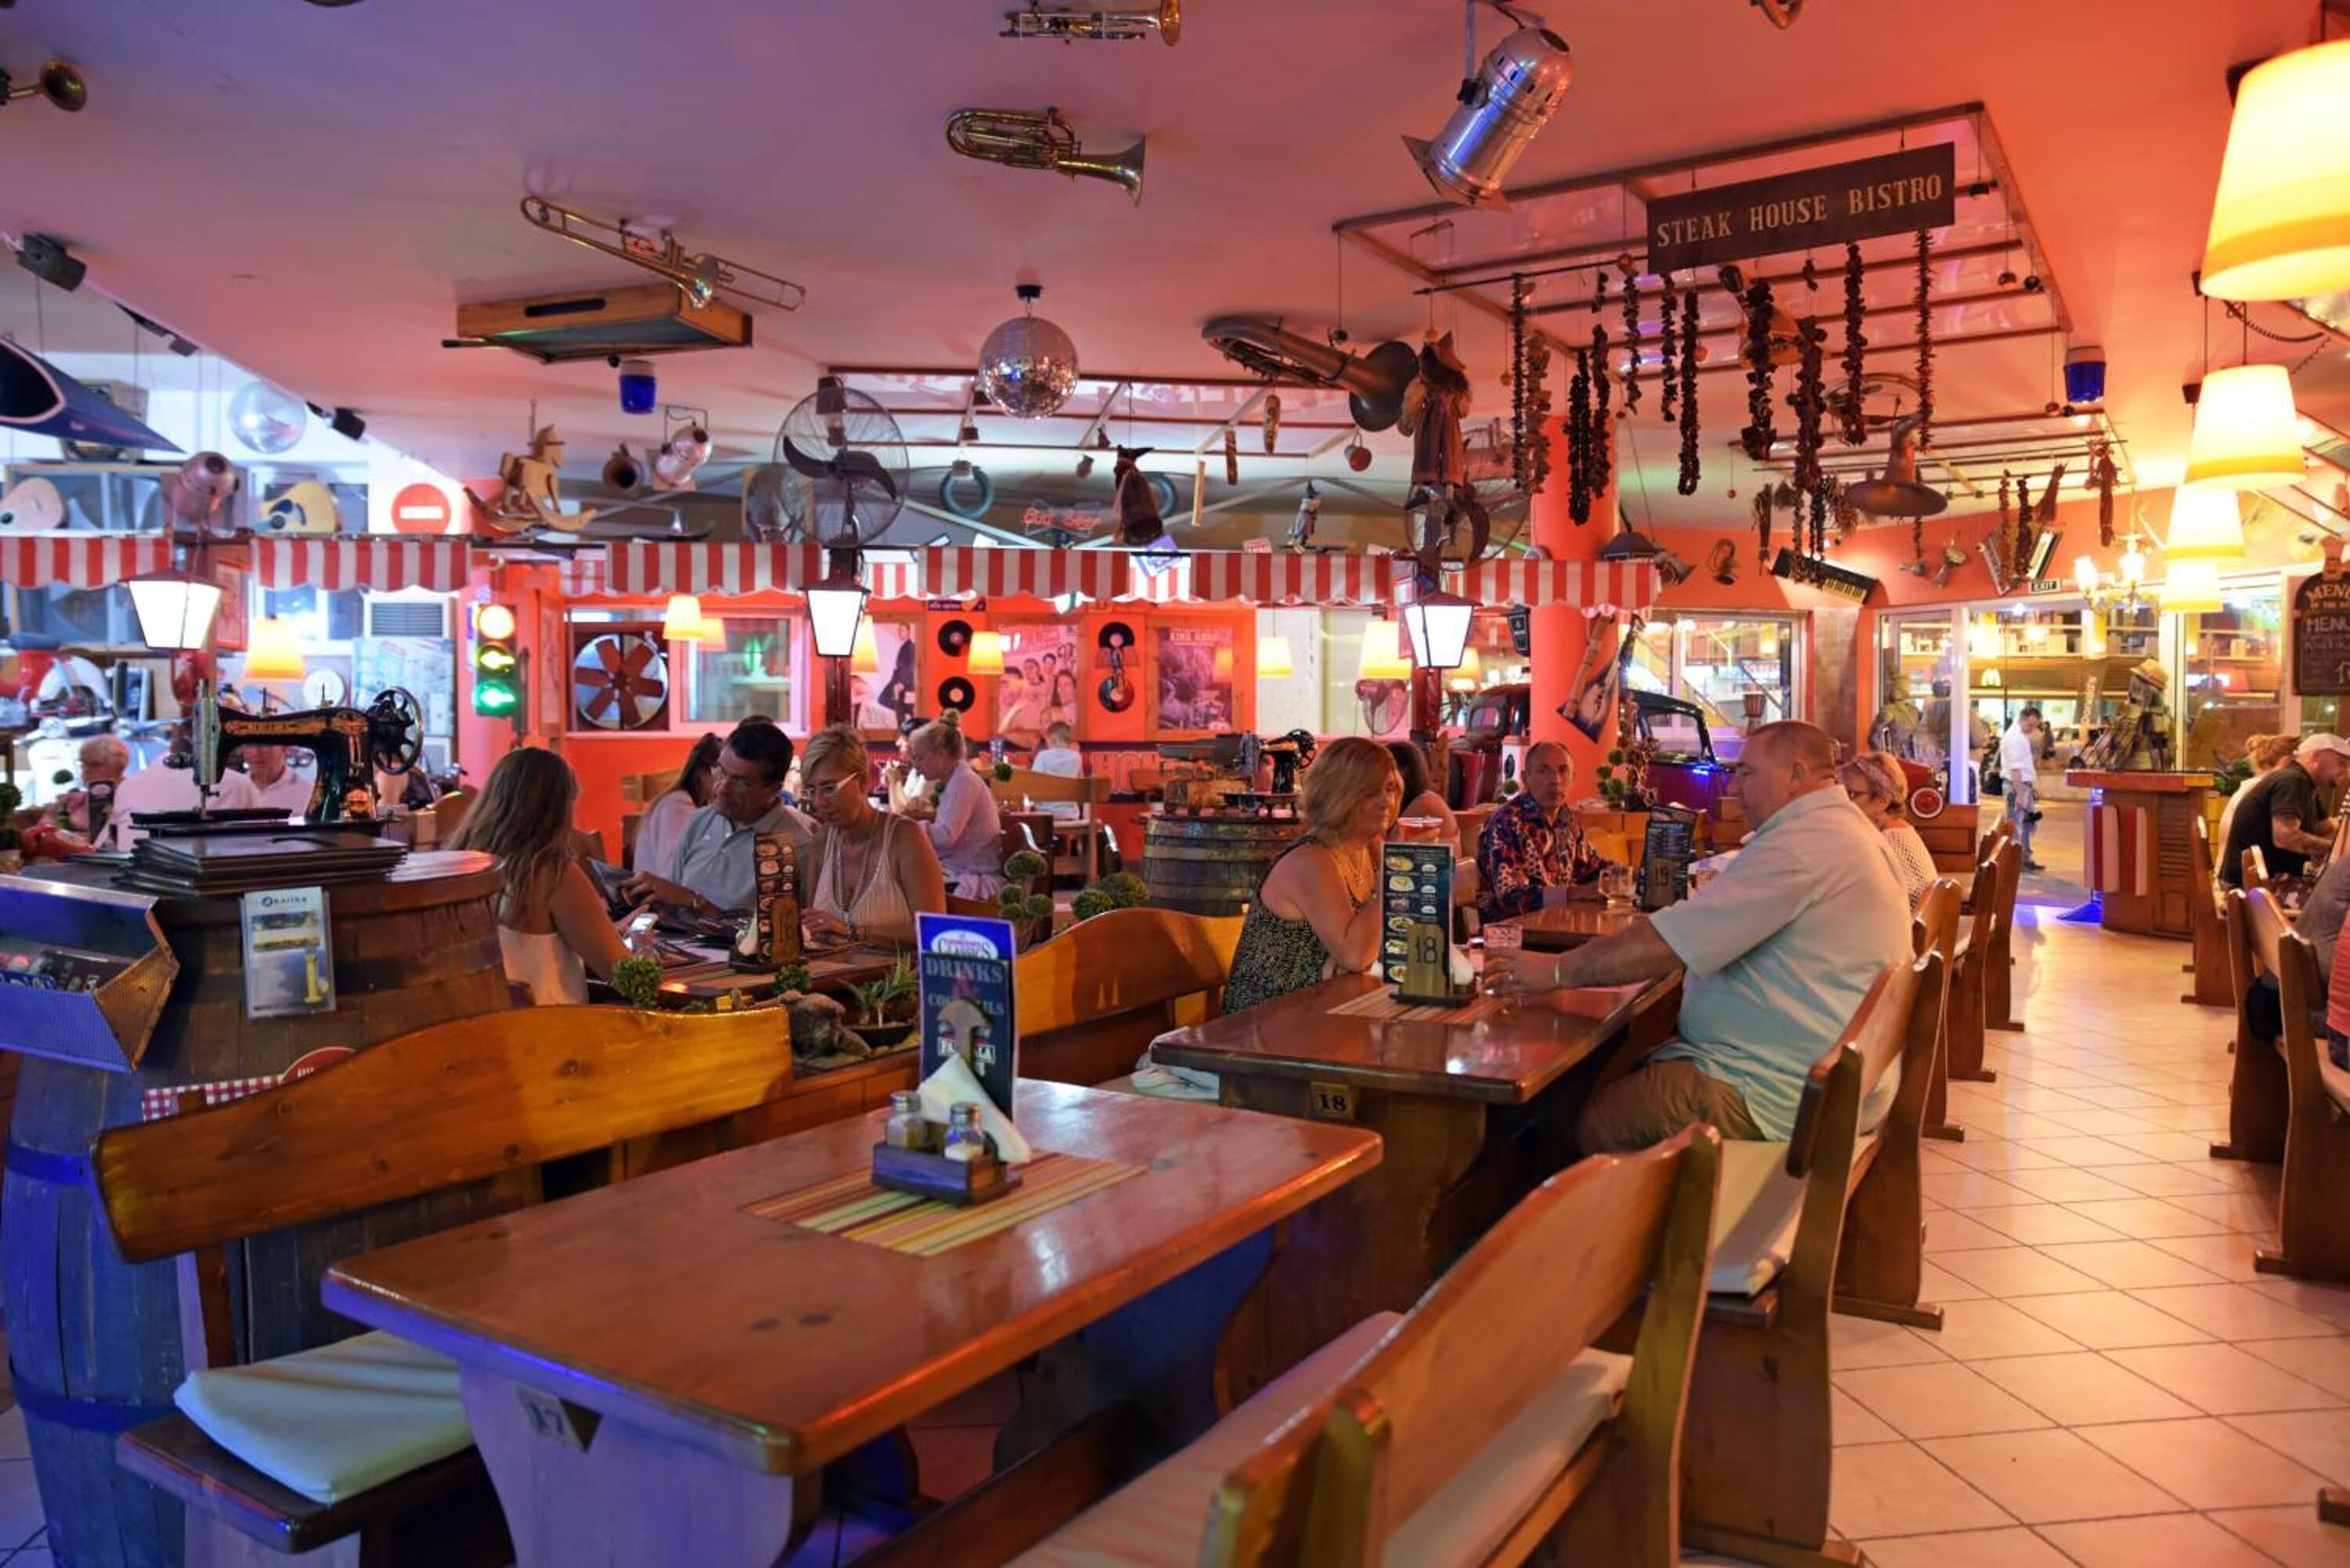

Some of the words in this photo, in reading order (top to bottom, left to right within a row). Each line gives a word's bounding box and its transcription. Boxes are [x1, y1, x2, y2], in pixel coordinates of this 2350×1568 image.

[1657, 211, 1734, 247] STEAK
[1749, 194, 1828, 232] HOUSE
[1847, 174, 1943, 215] BISTRO
[2033, 581, 2054, 592] EXIT
[1415, 935, 1437, 964] 18
[925, 957, 1003, 984] DRINKS
[1320, 1093, 1347, 1112] 18
